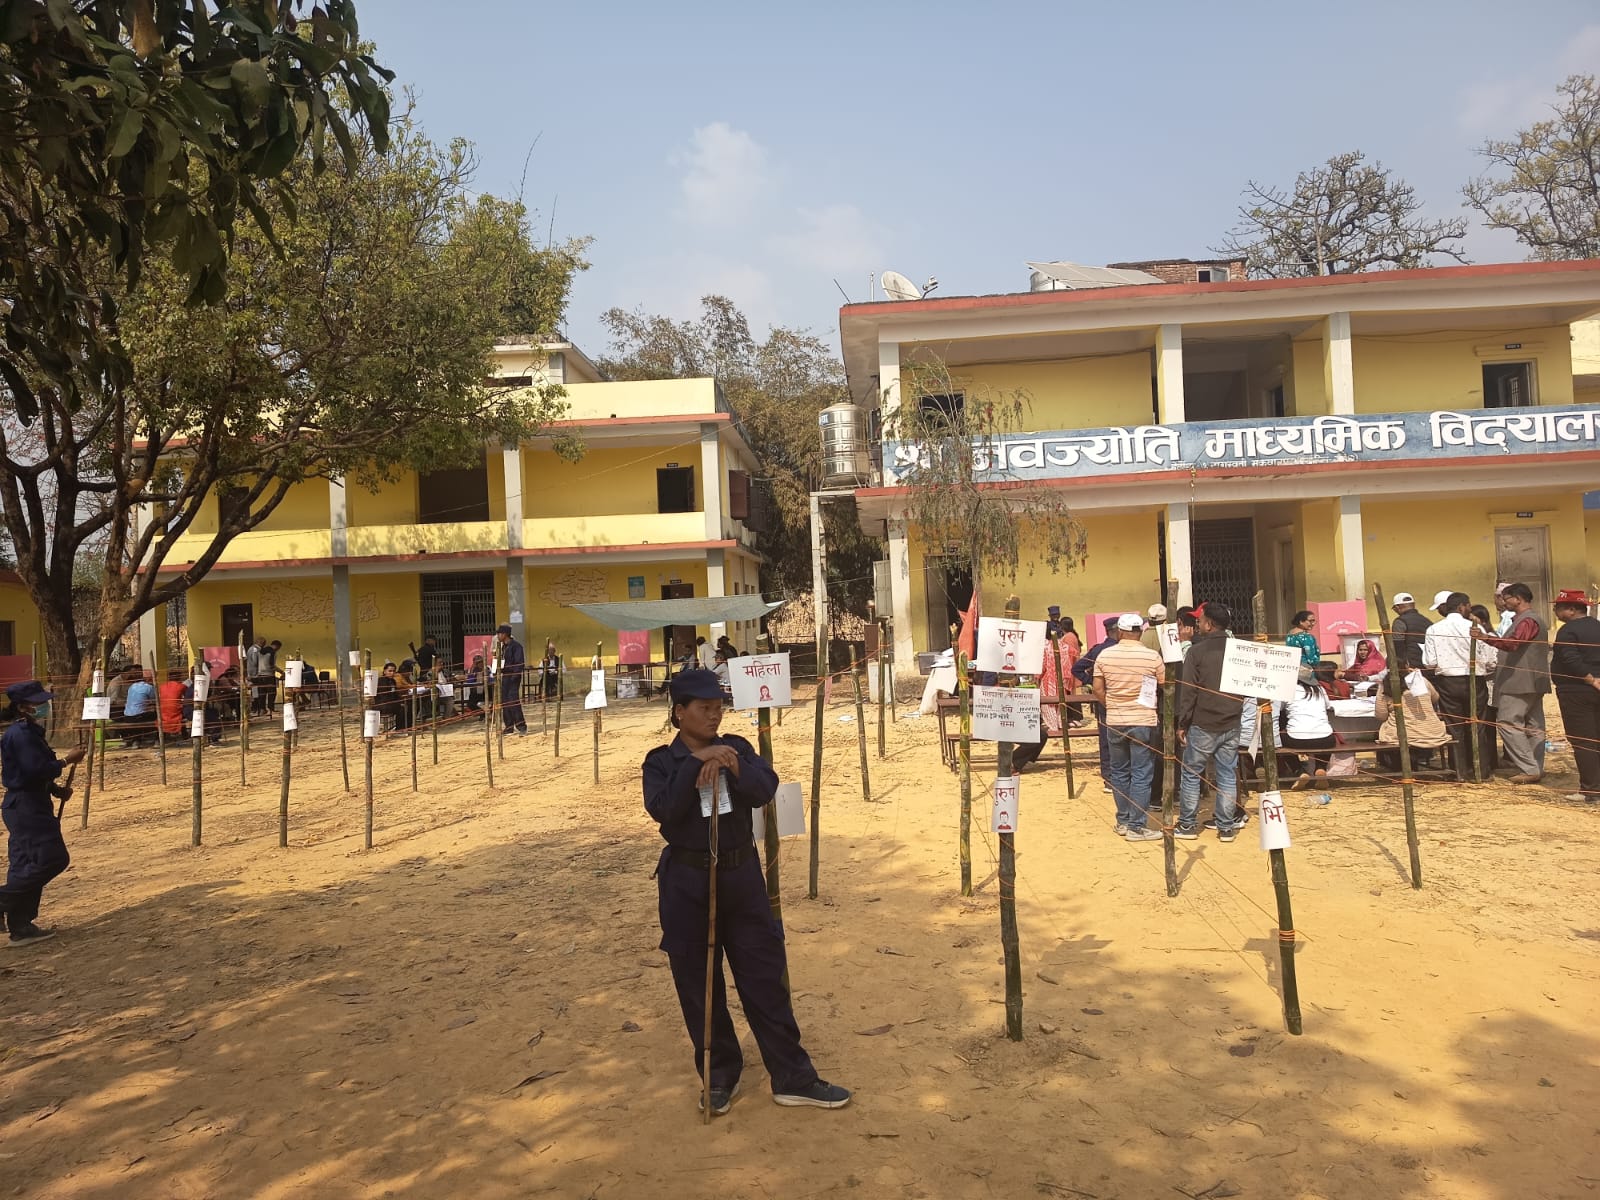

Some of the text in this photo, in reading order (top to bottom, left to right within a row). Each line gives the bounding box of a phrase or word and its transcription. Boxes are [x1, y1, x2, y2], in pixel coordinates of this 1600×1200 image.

[1205, 415, 1406, 459] माध्यमिक
[1429, 410, 1600, 454] विद्याल
[742, 660, 781, 679] महिला
